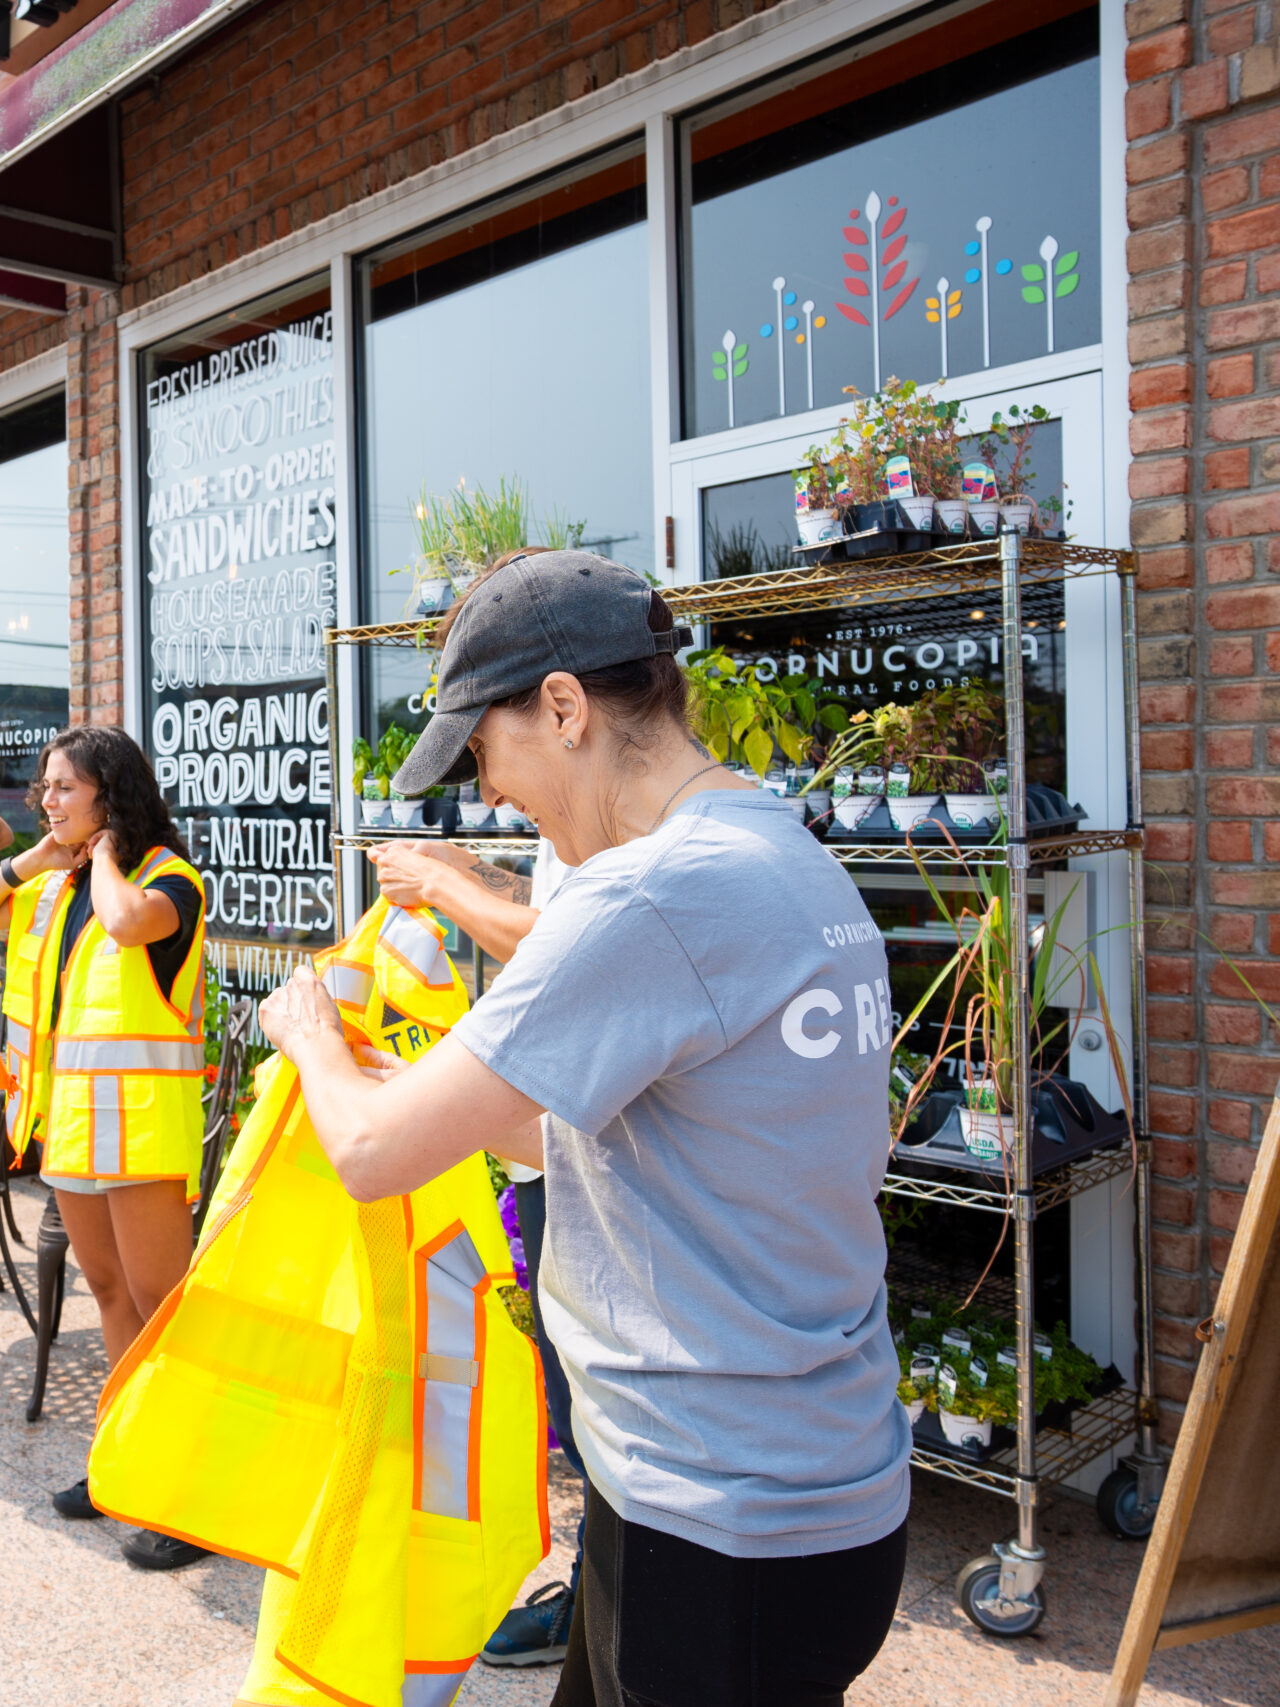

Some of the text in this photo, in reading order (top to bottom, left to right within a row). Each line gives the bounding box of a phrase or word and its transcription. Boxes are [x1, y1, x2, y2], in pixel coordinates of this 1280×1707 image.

[171, 372, 333, 469] SMOOTHIES
[147, 487, 335, 585] SANDWICHES
[150, 561, 335, 636] HOUSEMADE
[835, 624, 903, 640] EST 1976
[152, 688, 329, 756] ORGANIC
[155, 748, 331, 807] PRODUCE
[781, 975, 892, 1059] CRE
